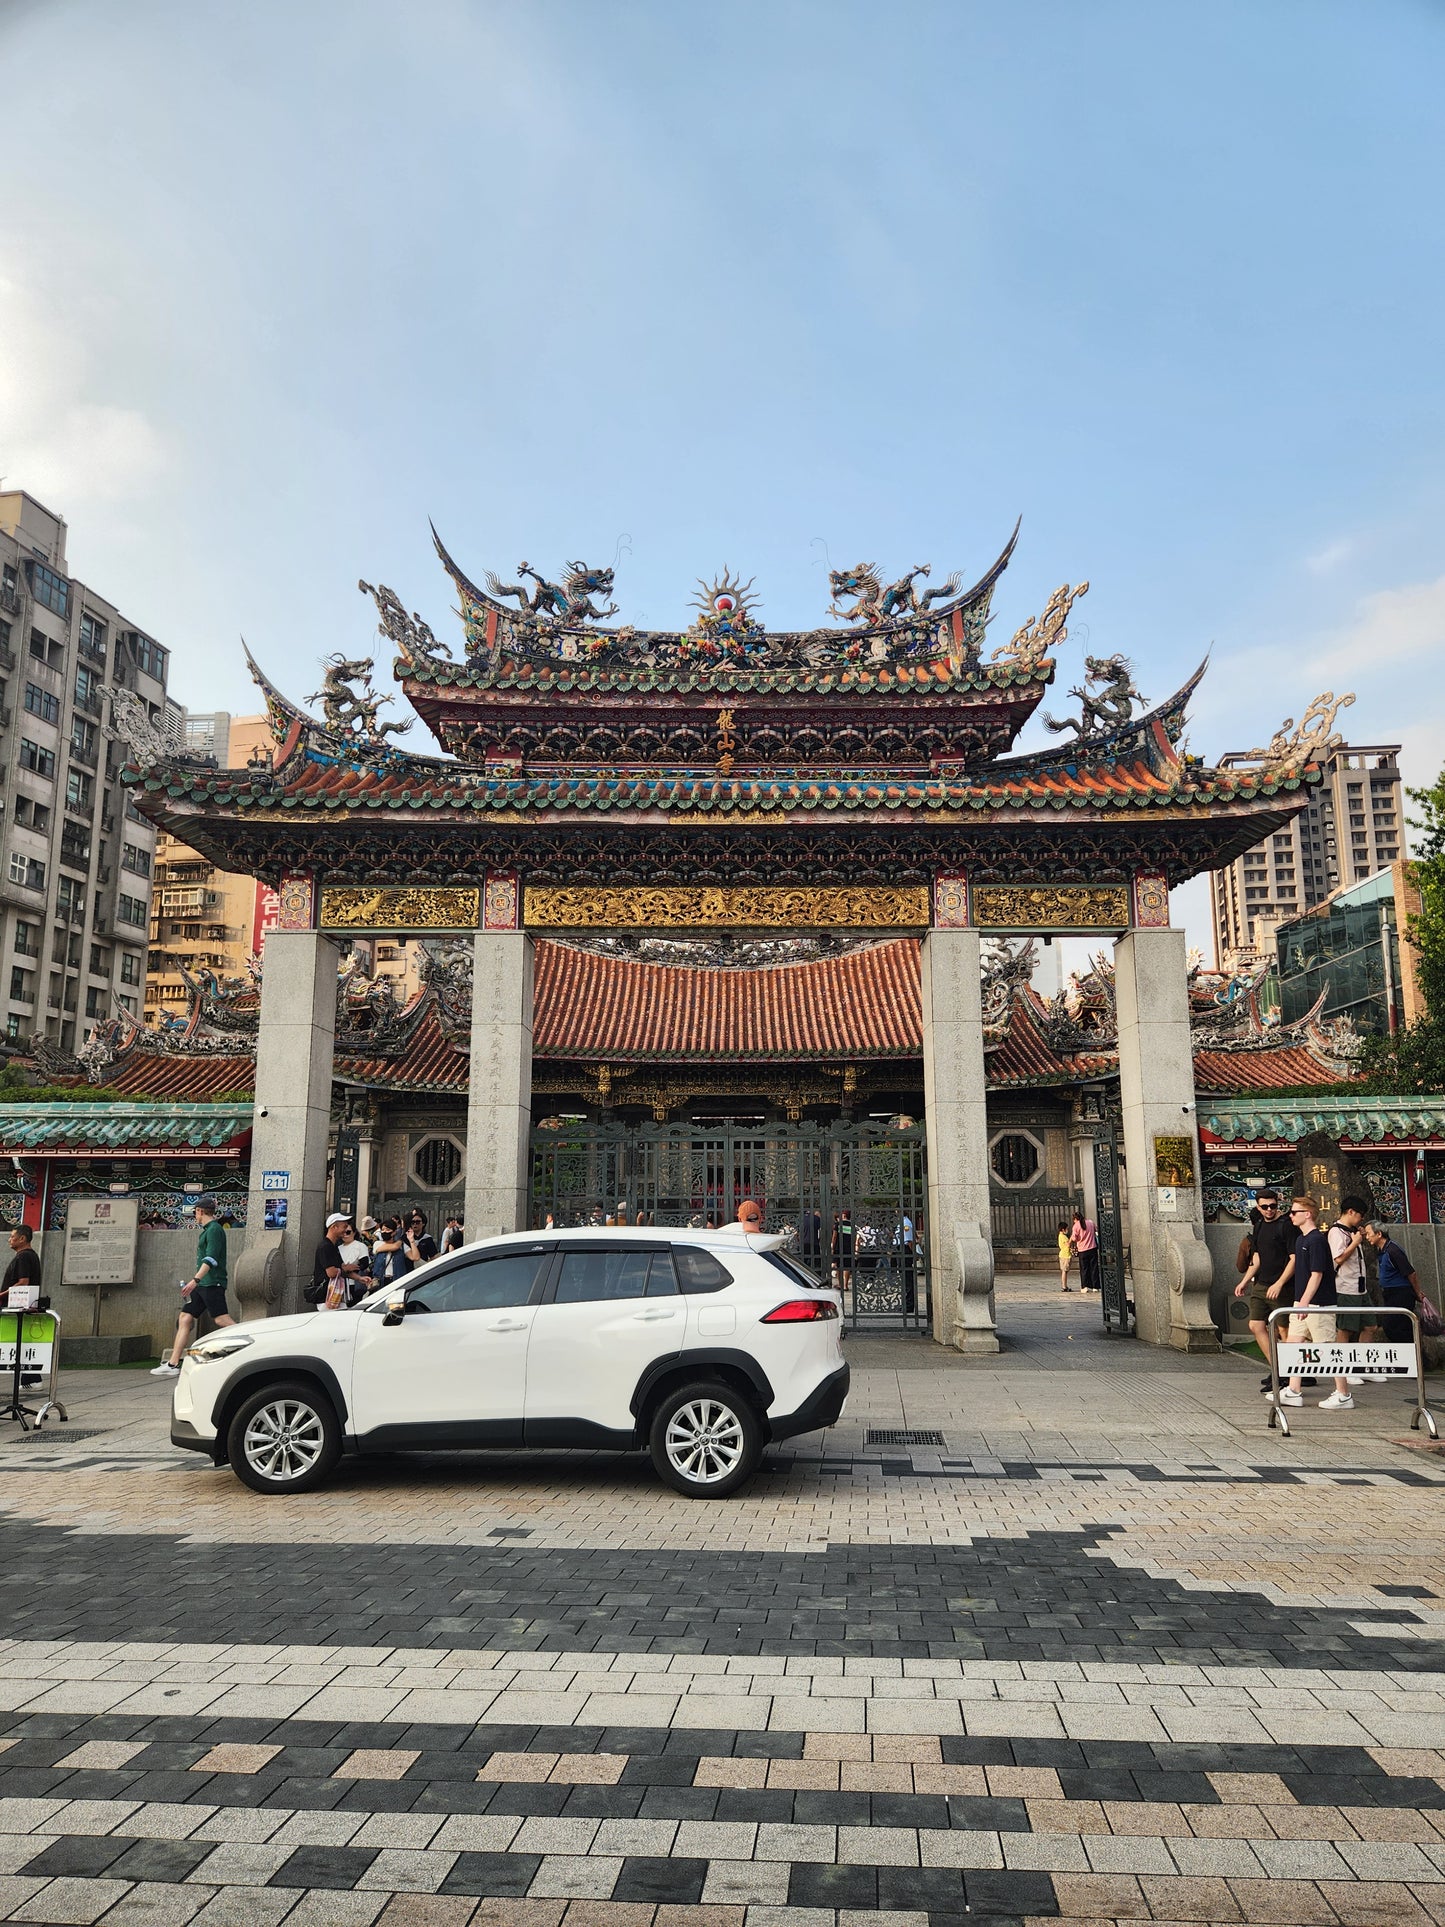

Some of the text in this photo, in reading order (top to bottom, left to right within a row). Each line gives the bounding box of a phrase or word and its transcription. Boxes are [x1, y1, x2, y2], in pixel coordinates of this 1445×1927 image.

[715, 709, 737, 776] 龍山寺
[266, 1178, 285, 1188] 211
[1329, 1348, 1399, 1364] 禁止停車
